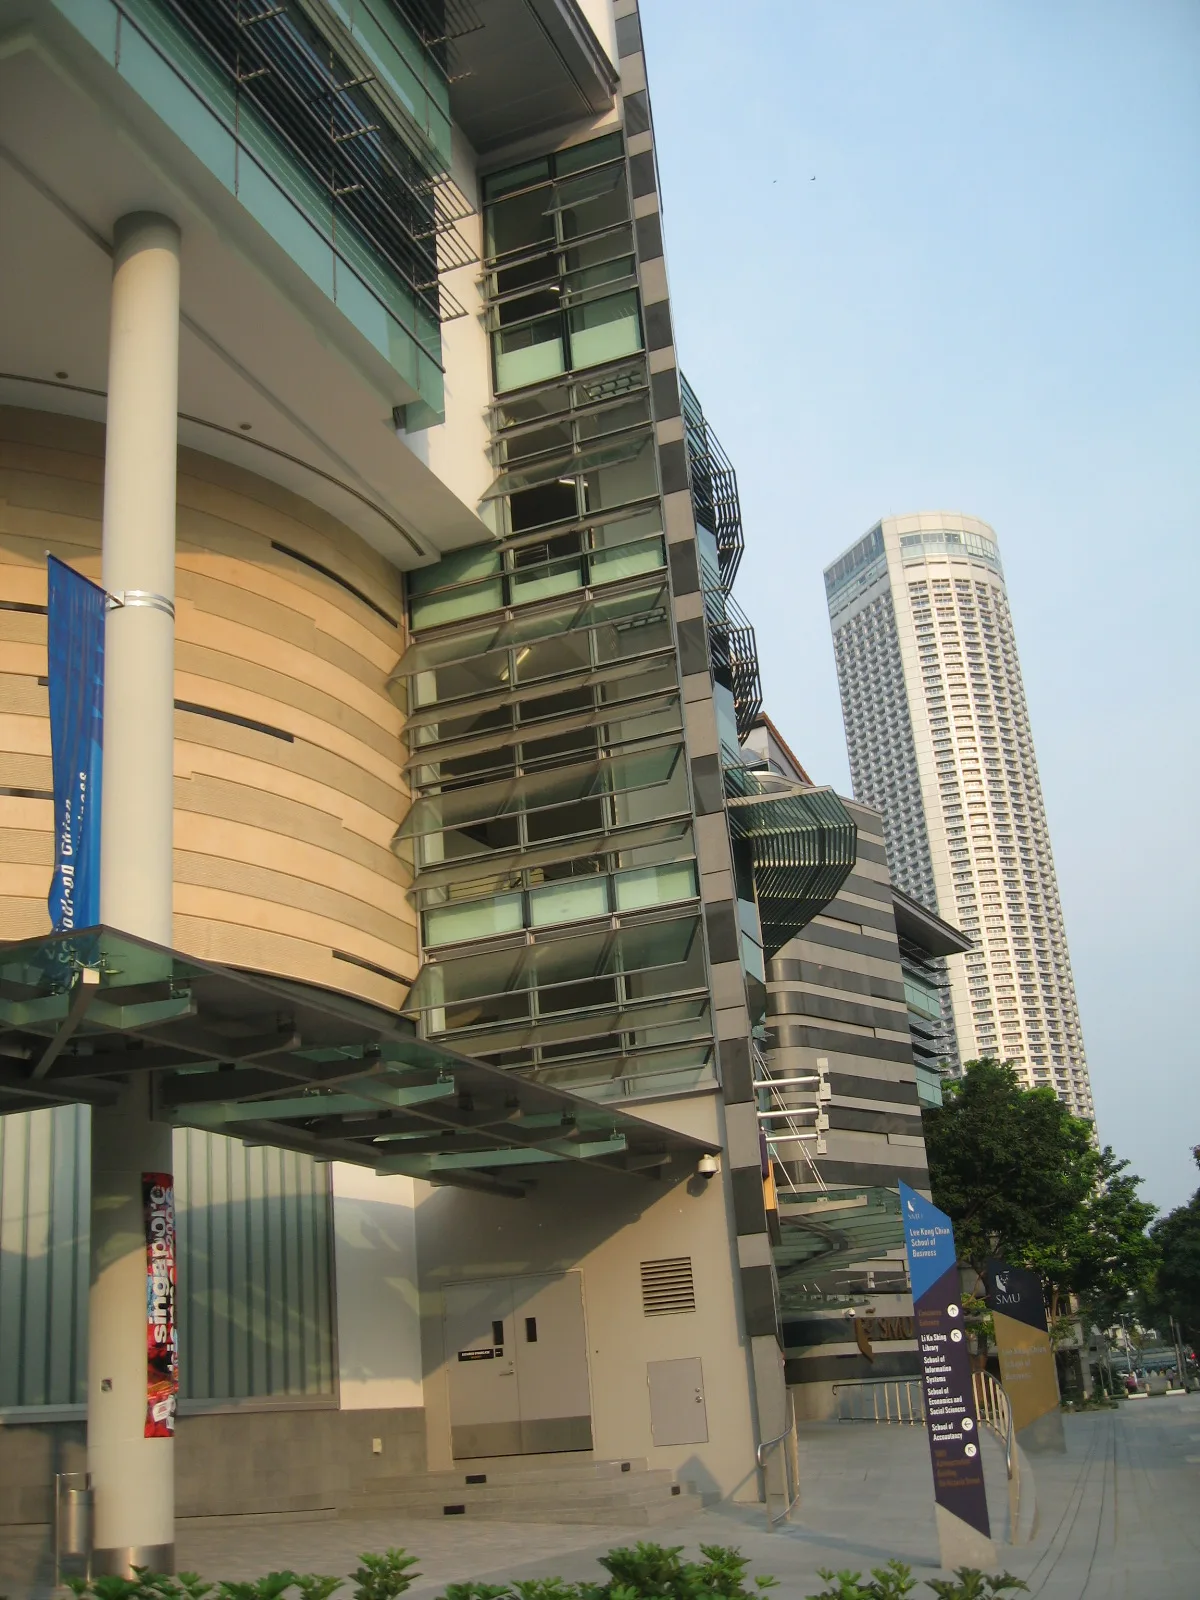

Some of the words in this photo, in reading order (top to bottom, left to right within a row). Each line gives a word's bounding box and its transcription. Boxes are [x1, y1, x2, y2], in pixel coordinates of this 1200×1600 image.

[909, 1228, 920, 1236] Lee
[920, 1228, 934, 1237] Kong
[934, 1226, 950, 1235] Chian
[911, 1238, 929, 1247] School
[930, 1237, 936, 1246] of
[912, 1249, 937, 1258] Business
[149, 1185, 169, 1344] singapore
[995, 1292, 1021, 1305] SMU
[877, 1317, 913, 1339] SMU
[921, 1334, 926, 1342] Li
[927, 1334, 933, 1342] Ka
[933, 1333, 947, 1342] Shing
[922, 1344, 939, 1352] Library
[923, 1355, 939, 1364] School
[939, 1355, 945, 1363] of
[924, 1365, 952, 1373] Information
[926, 1376, 946, 1384] Systems
[927, 1387, 942, 1395] School
[943, 1386, 949, 1394] of
[928, 1397, 953, 1405] Economics
[953, 1395, 963, 1403] and
[929, 1407, 944, 1416] Social
[945, 1406, 966, 1414] Sciences
[931, 1423, 947, 1431] School
[948, 1422, 953, 1430] of
[933, 1432, 963, 1441] Accountancy
